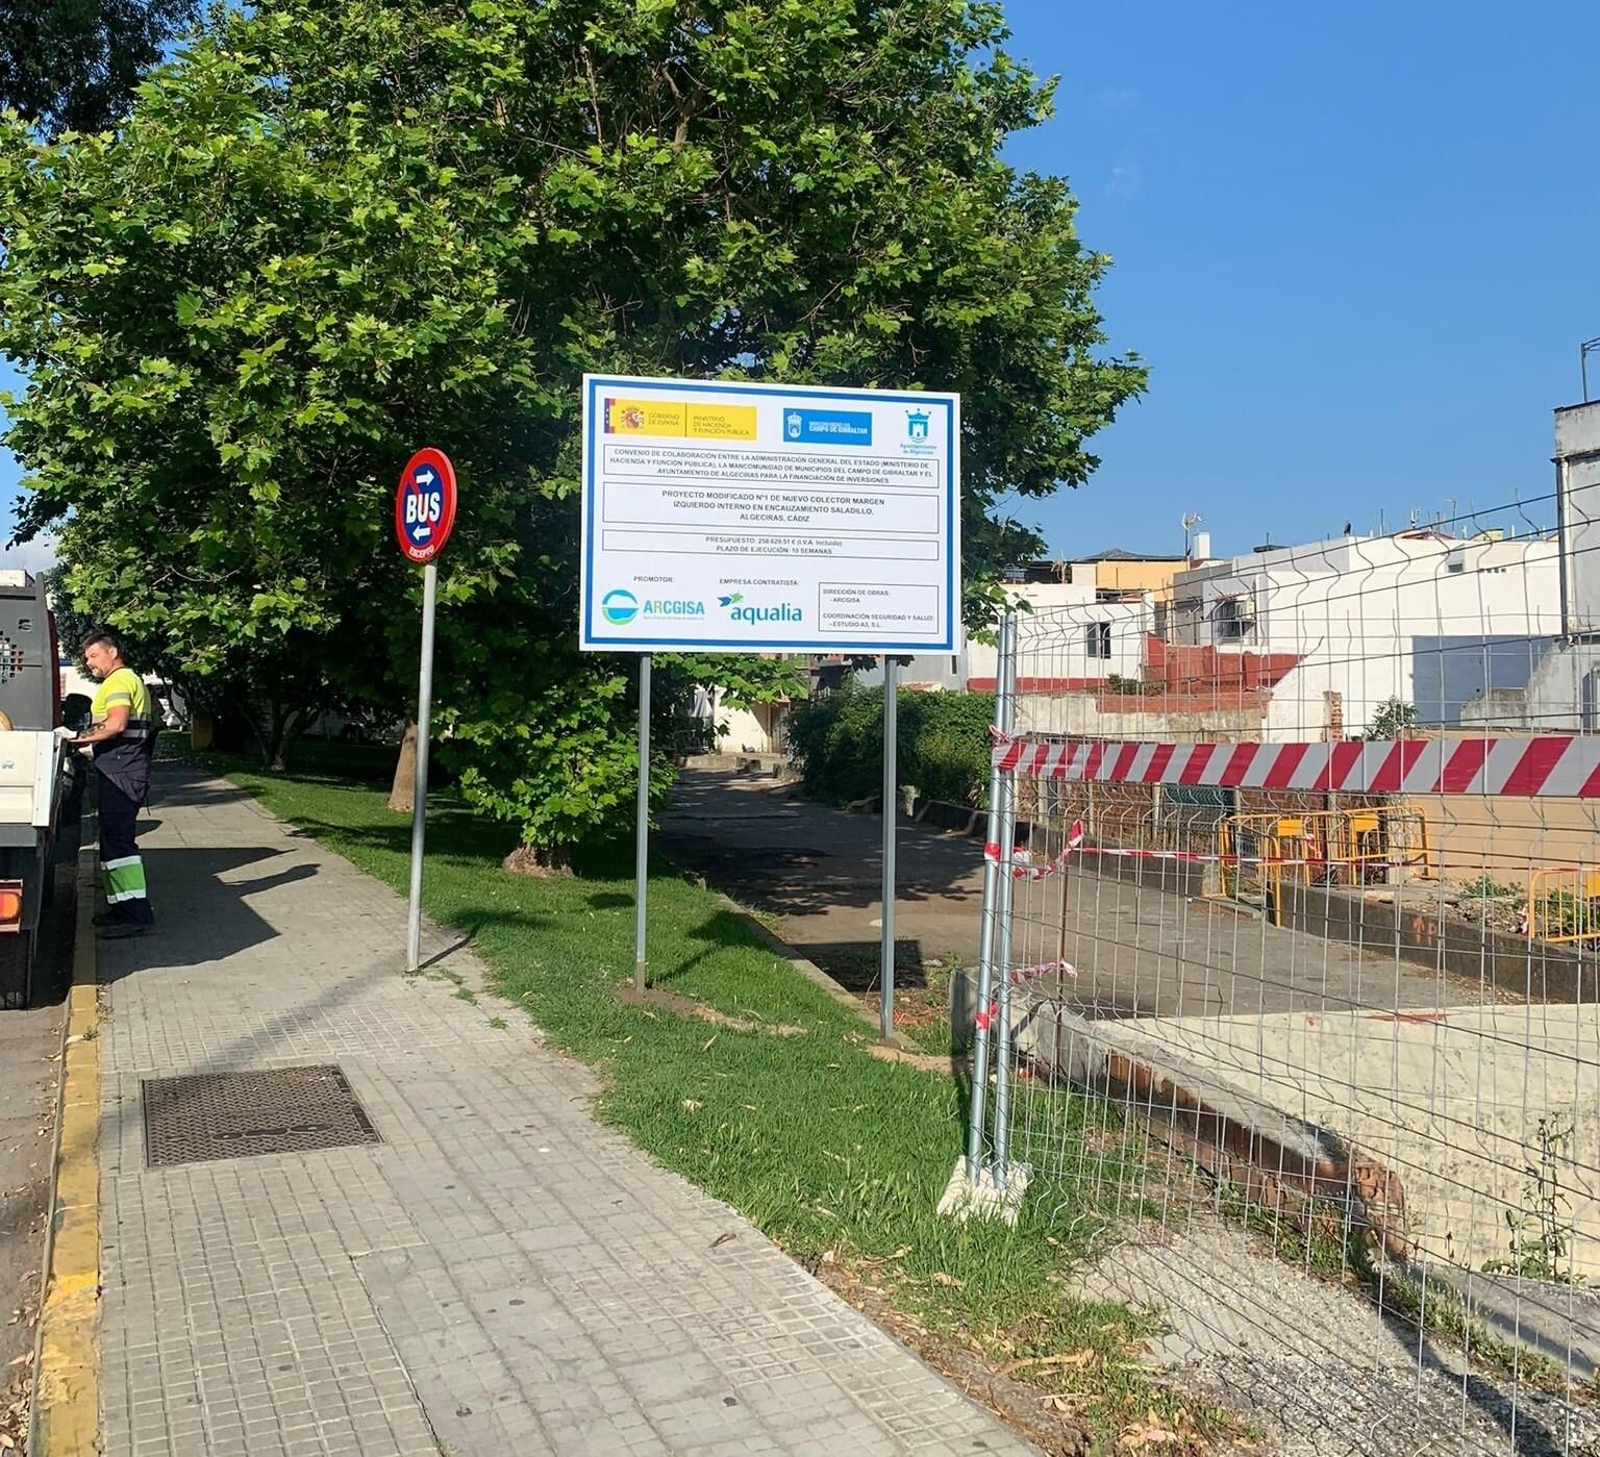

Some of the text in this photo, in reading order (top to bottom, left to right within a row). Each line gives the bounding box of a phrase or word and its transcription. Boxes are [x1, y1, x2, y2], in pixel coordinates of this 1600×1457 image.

[615, 448, 650, 456] CONVENIO
[662, 451, 716, 459] COLABORACIÓN
[751, 455, 807, 463] ADMINISTRACIÓN
[881, 461, 919, 469] (MINISTERIO
[610, 457, 646, 465] HACIENDA
[653, 459, 683, 467] FUNCIÓN
[729, 462, 783, 471] MANCOMUNIDAD
[882, 469, 918, 477] GIBRALTAR
[657, 468, 709, 476] AYUNTAMIENTO
[789, 473, 835, 482] FINANCIACIÓN
[847, 476, 889, 484] INVERSIONES
[662, 490, 704, 499] PROYECTO
[706, 492, 754, 501] MODIFICADO
[783, 495, 808, 503] NUEVO
[810, 496, 851, 504] COLECTOR
[406, 492, 440, 524] BUS
[674, 501, 716, 509] IZQUIERDO
[717, 503, 751, 511] INTERNO
[765, 504, 829, 513] ENCAUZAMIENTO
[830, 507, 874, 515] SALADILLO,
[740, 513, 810, 523] ALGECIRAS, CÁDIZ
[706, 536, 755, 544] PRESUPUESTO:
[643, 600, 705, 615] ARCGISA
[731, 602, 802, 625] aqualia
